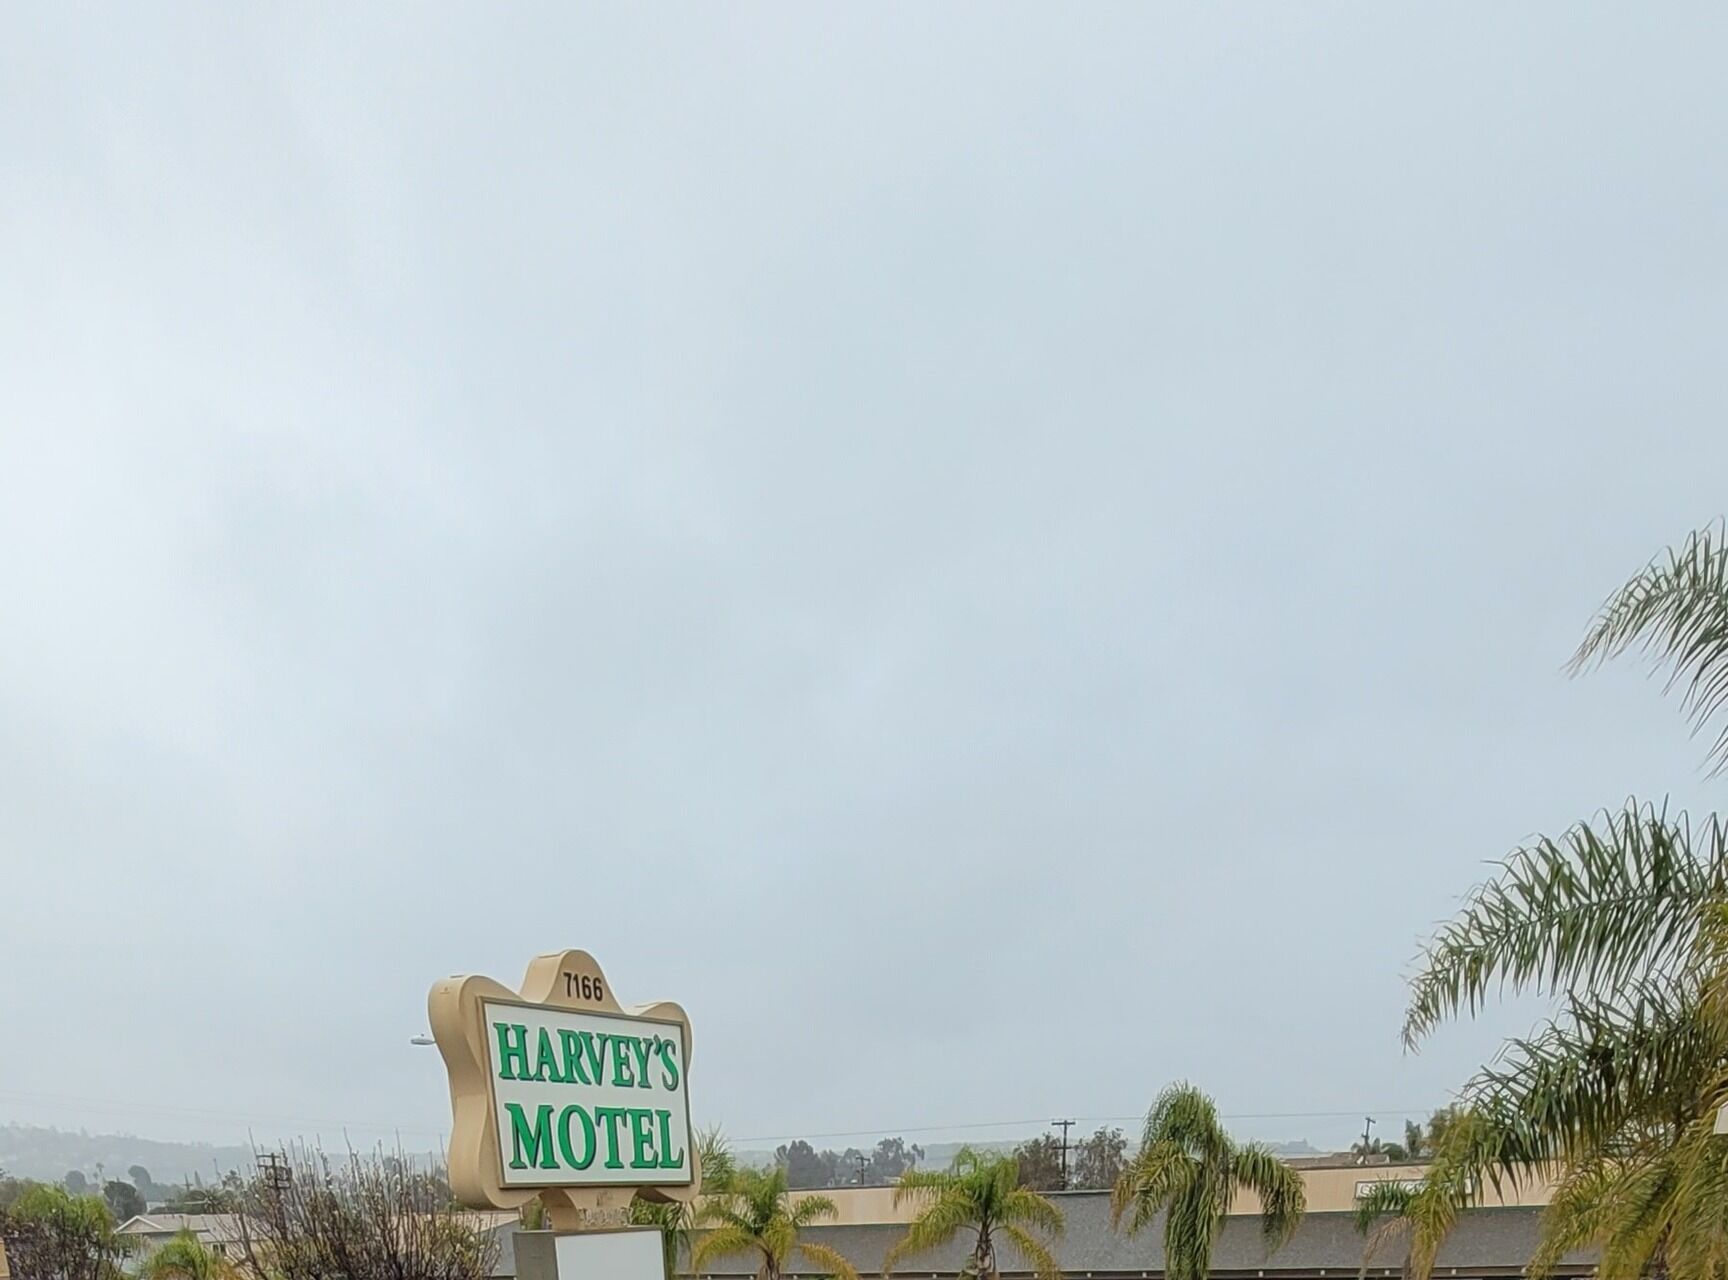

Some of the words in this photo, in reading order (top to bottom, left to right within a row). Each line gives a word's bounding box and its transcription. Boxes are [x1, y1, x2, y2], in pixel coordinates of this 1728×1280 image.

[563, 972, 603, 1001] 7166
[493, 1022, 679, 1091] HARVEY'S
[504, 1103, 685, 1171] MOTEL
